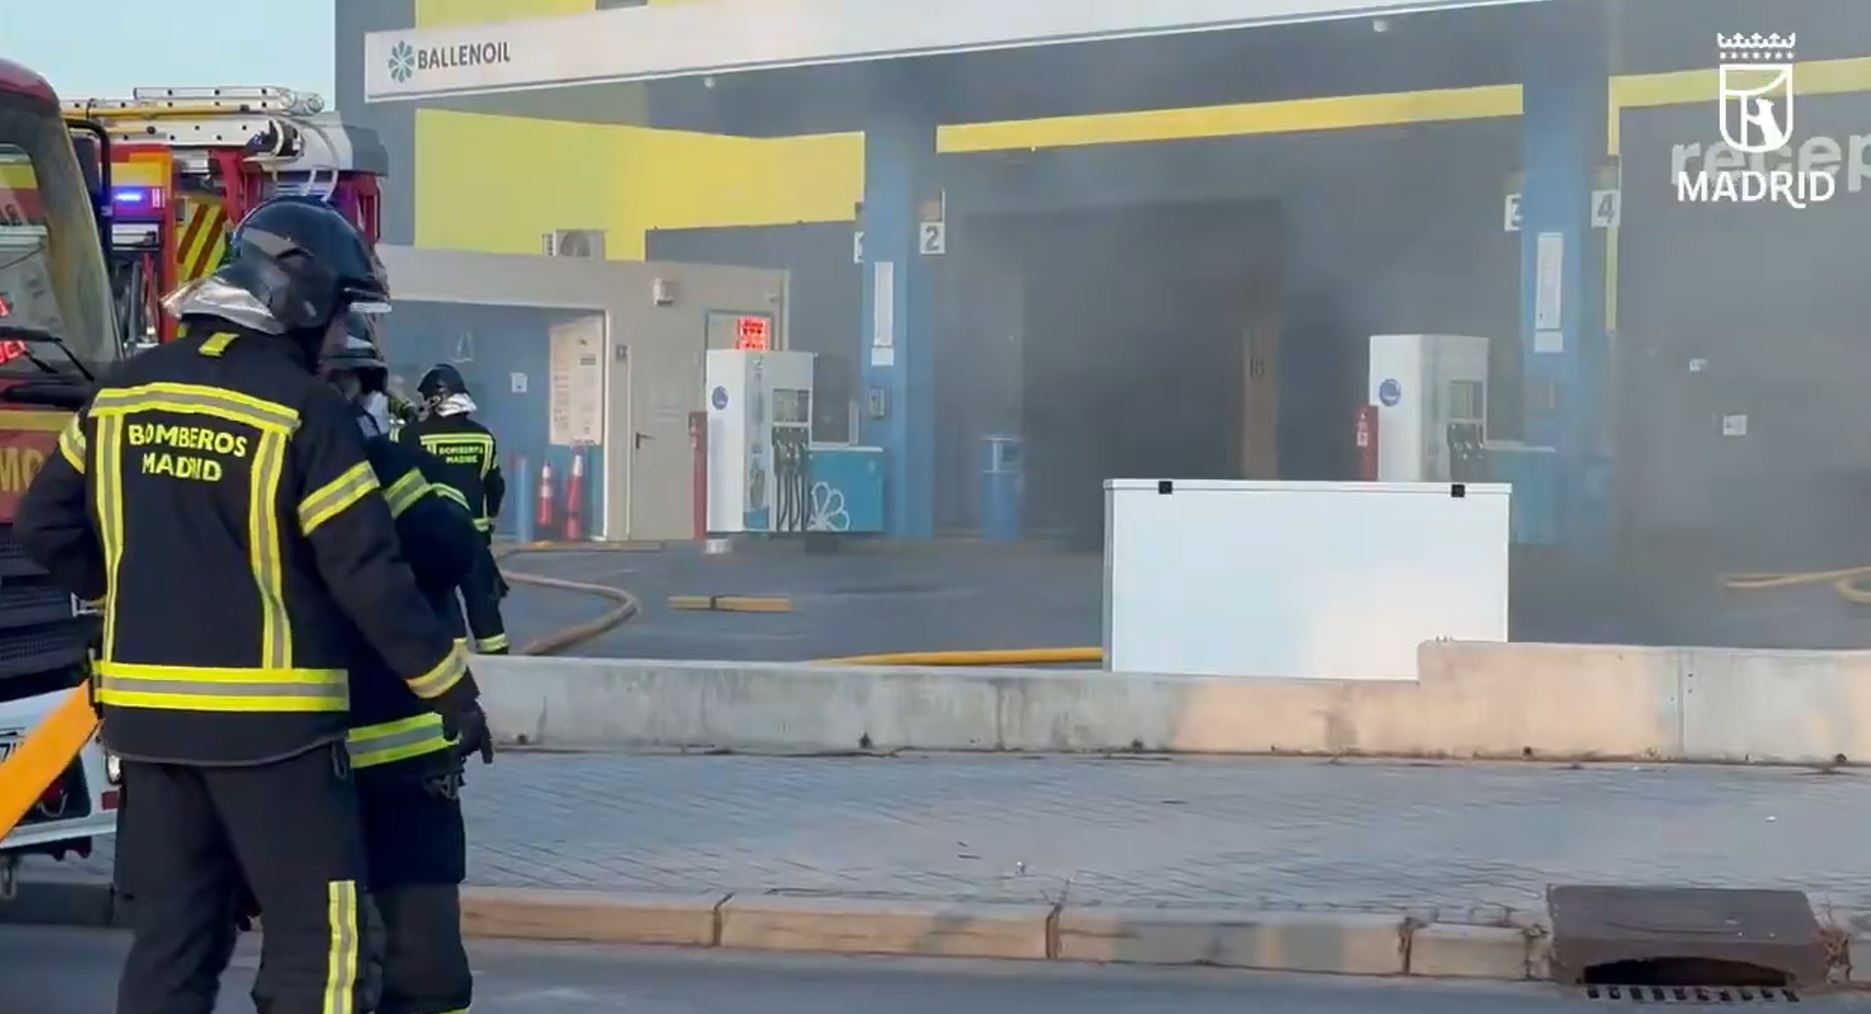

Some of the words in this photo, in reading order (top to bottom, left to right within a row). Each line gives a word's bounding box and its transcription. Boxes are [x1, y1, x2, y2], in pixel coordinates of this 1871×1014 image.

[418, 41, 510, 70] BALLENOIL
[1598, 193, 1615, 224] 4
[925, 225, 940, 251] 2
[128, 423, 248, 458] BOMBEROS
